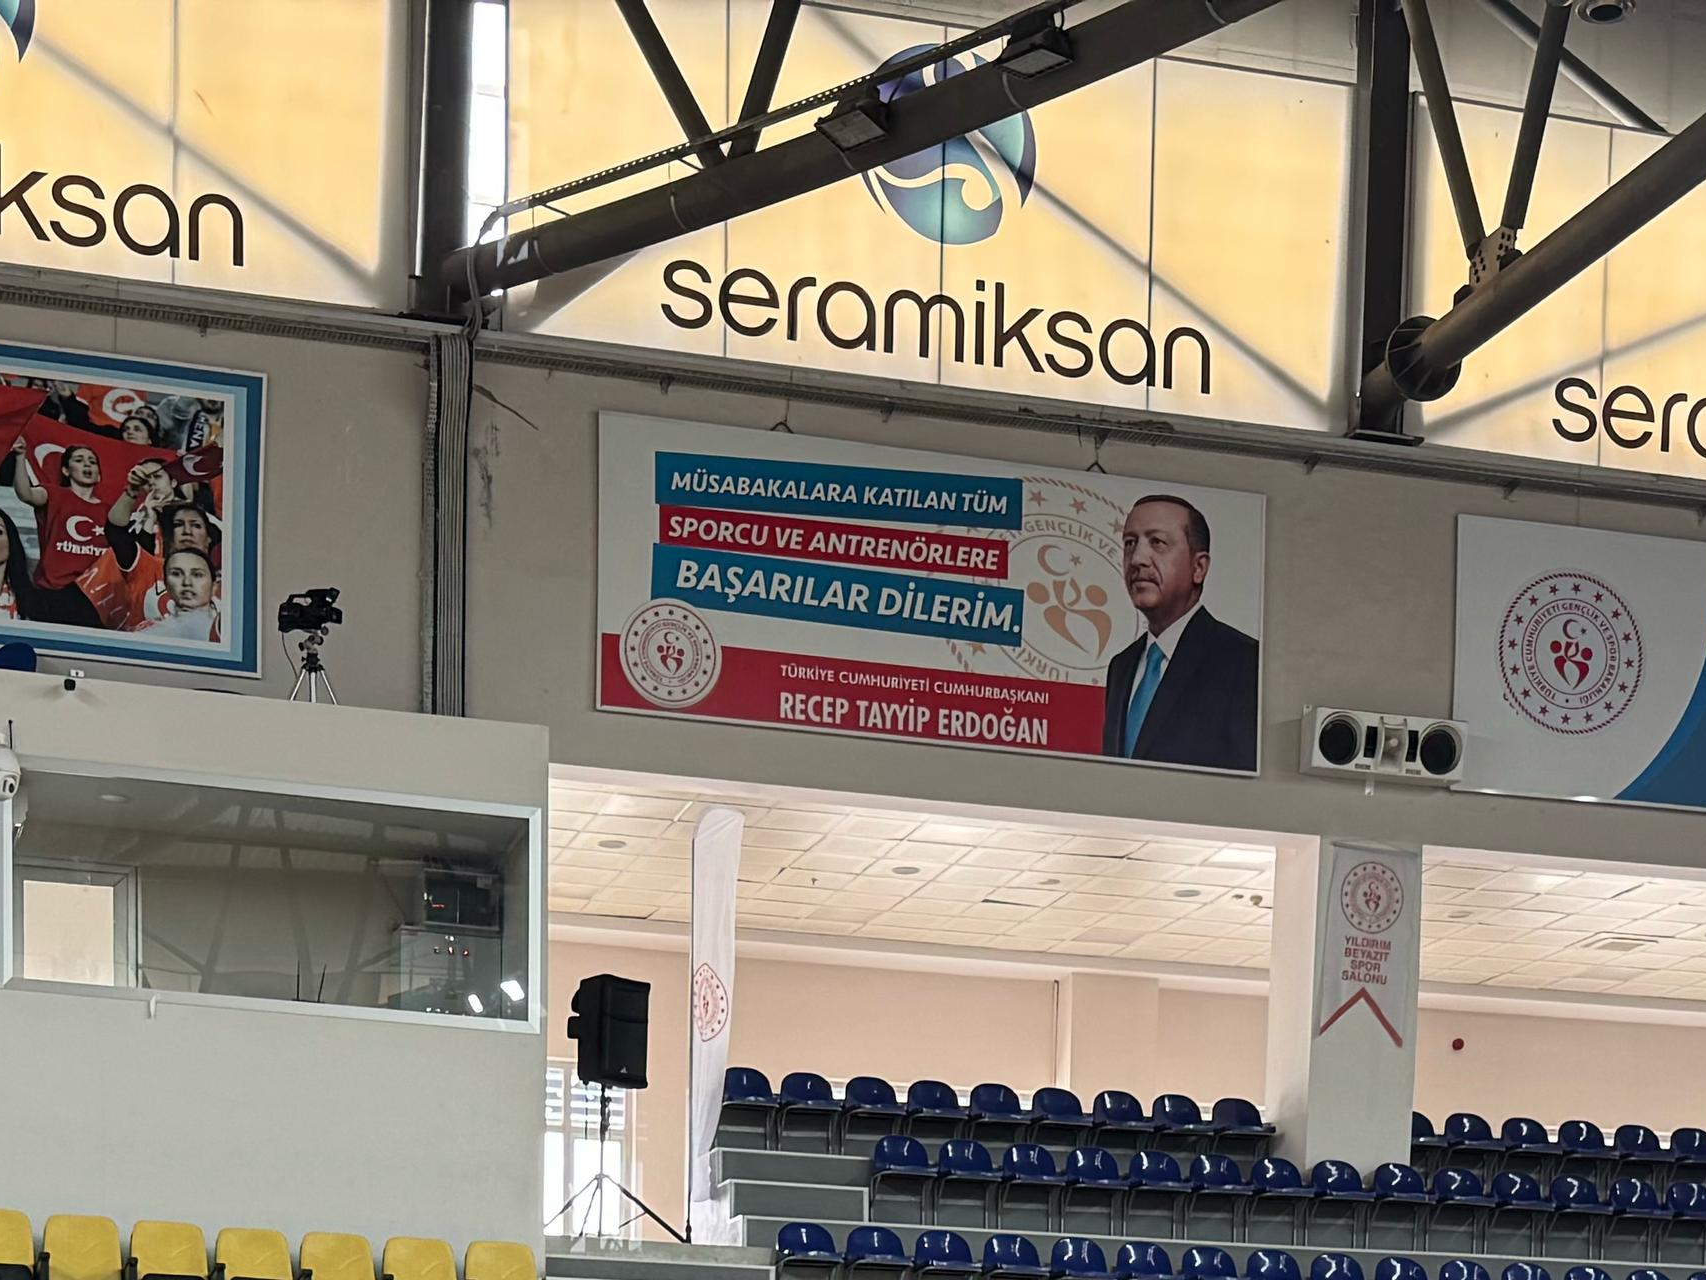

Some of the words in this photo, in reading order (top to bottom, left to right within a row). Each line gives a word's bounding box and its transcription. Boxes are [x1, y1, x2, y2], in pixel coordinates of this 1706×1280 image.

[660, 259, 1211, 394] seramiksan
[671, 469, 857, 504] MÜSABAKALARA
[863, 486, 955, 510] KATILAN
[961, 491, 1007, 515] TÜM
[668, 516, 769, 546] SPORCU
[774, 528, 804, 550] VE
[808, 530, 1000, 570] ANTRENÖRLERE
[676, 560, 870, 613] BAŞARILAR
[877, 581, 1021, 633] DİLERİM.
[780, 664, 835, 683] TÜRKİYE
[838, 671, 930, 693] CUMHURİYETİ
[933, 681, 1050, 705] CUMHURBAŞKANI
[779, 692, 849, 725] RECEP
[856, 698, 931, 734] TAYYİP
[938, 708, 1048, 745] ERDOĞAN
[1350, 960, 1381, 973] SPOR
